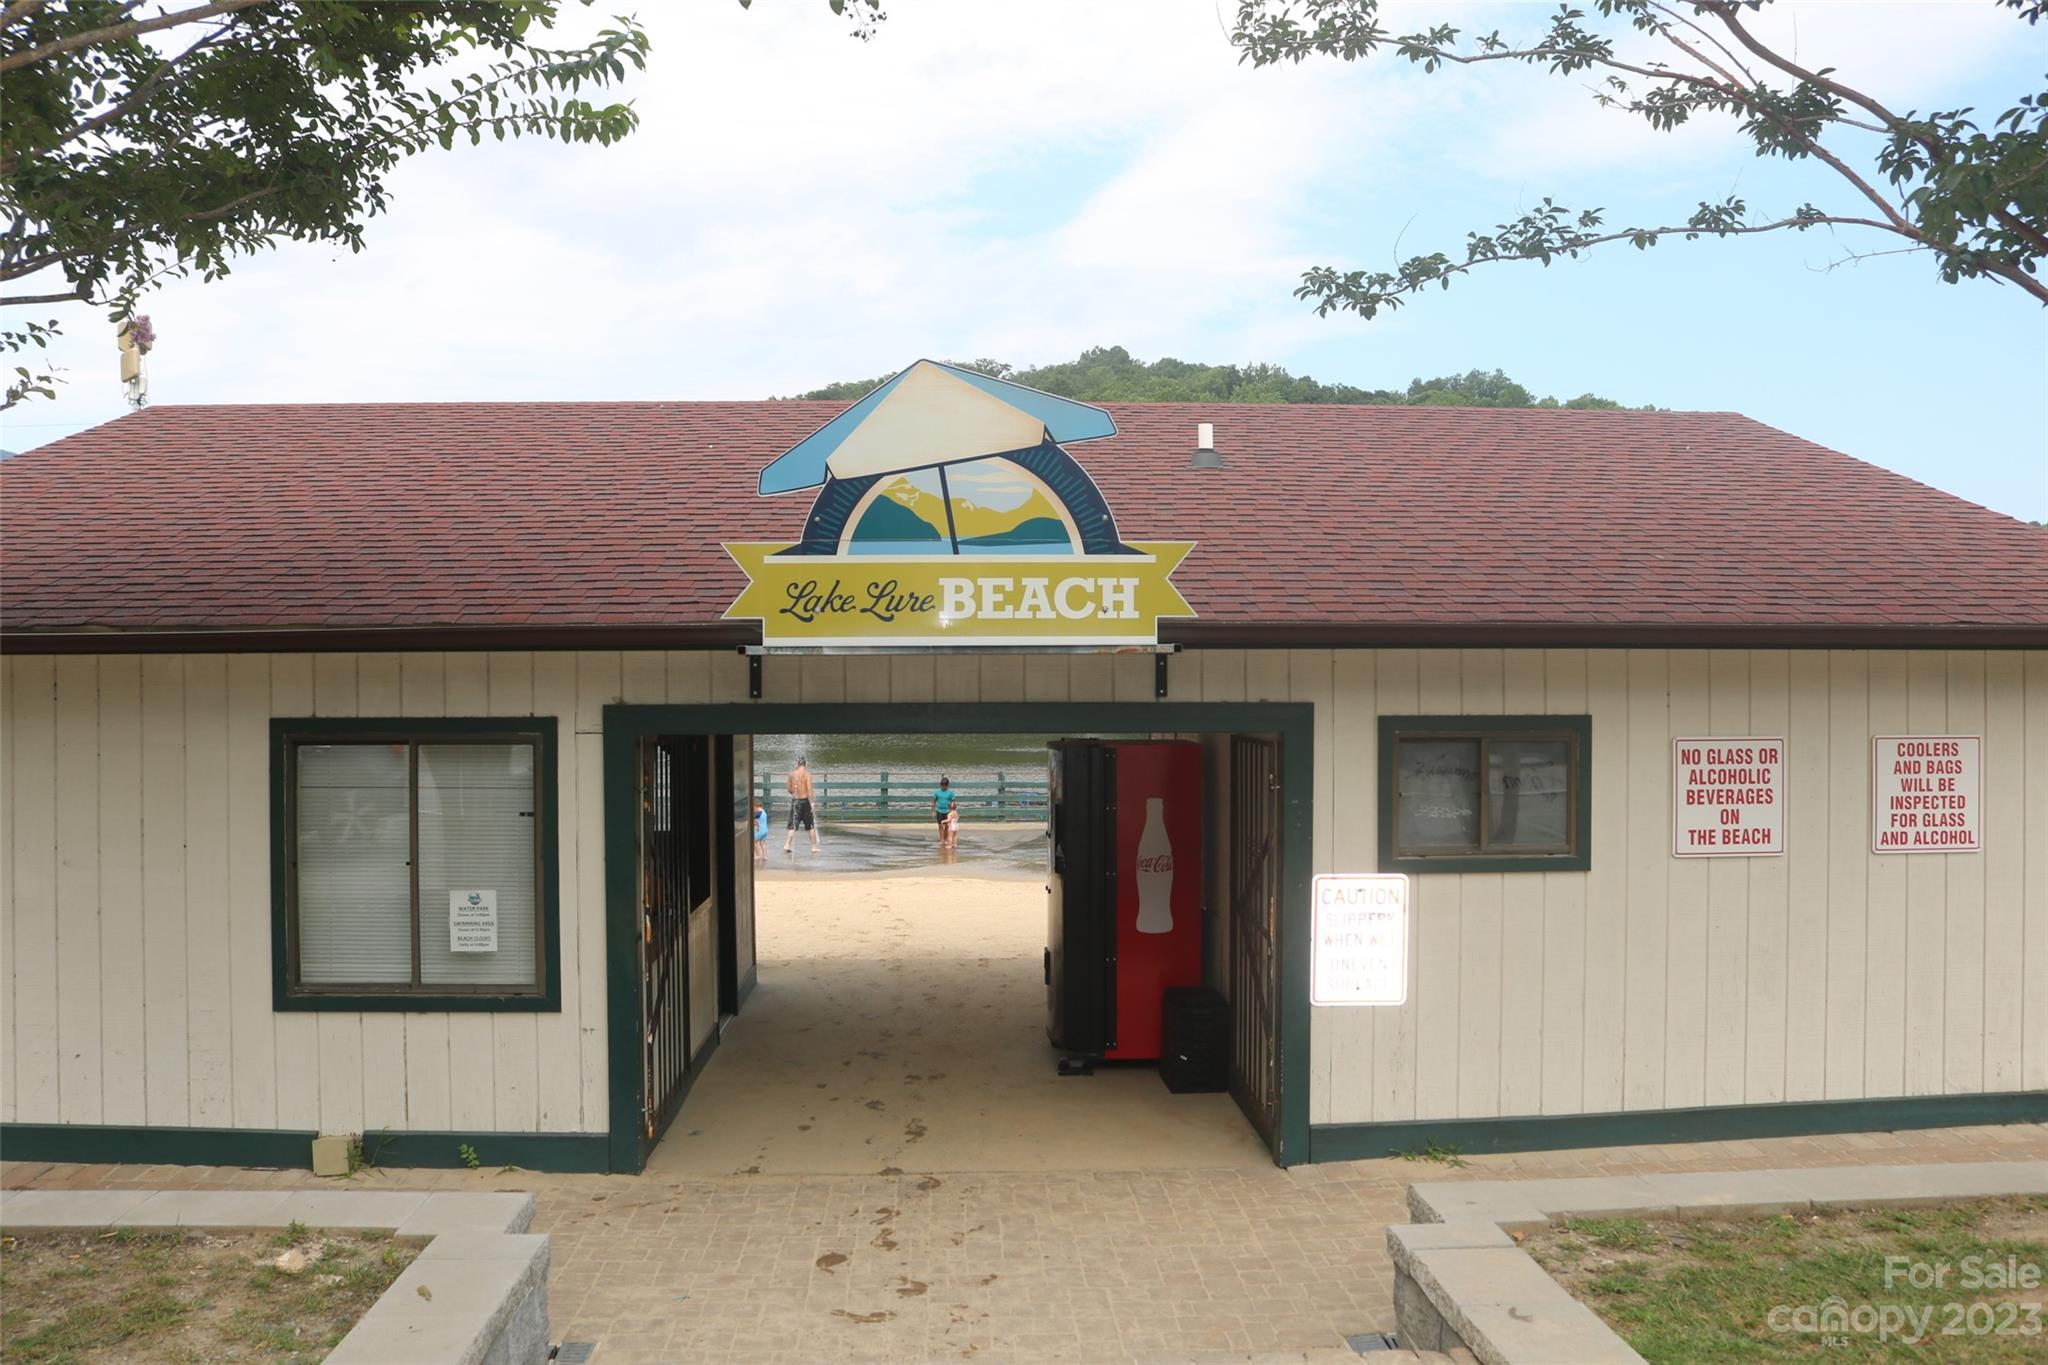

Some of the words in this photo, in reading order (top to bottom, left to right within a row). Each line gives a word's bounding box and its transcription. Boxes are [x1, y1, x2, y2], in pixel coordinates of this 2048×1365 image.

[779, 579, 856, 623] Lake
[860, 579, 936, 623] Lure
[938, 577, 1140, 619] BEACH
[1680, 749, 1701, 766] NO
[1706, 748, 1753, 765] GLASS
[1758, 748, 1779, 765] OR
[1897, 742, 1960, 757] COOLERS
[1893, 760, 1922, 775] AND
[1926, 759, 1963, 775] BAGS
[1688, 768, 1771, 786] ALCOHOLIC
[1900, 777, 1934, 793] WILL
[1938, 777, 1956, 793] BE
[1685, 787, 1774, 806] BEVERAGES
[1889, 795, 1967, 810] INSPECTED
[1720, 808, 1741, 825] ON
[1890, 813, 1918, 828] FOR
[1922, 812, 1966, 827] GLASS
[1688, 828, 1716, 846] THE
[1721, 828, 1772, 845] BEACH
[1880, 831, 1910, 846] AND
[1913, 830, 1975, 846] ALCOHOL
[1321, 888, 1400, 904] CAUTION
[1326, 912, 1395, 928] SLIPPERY
[1324, 932, 1363, 945] WHEN
